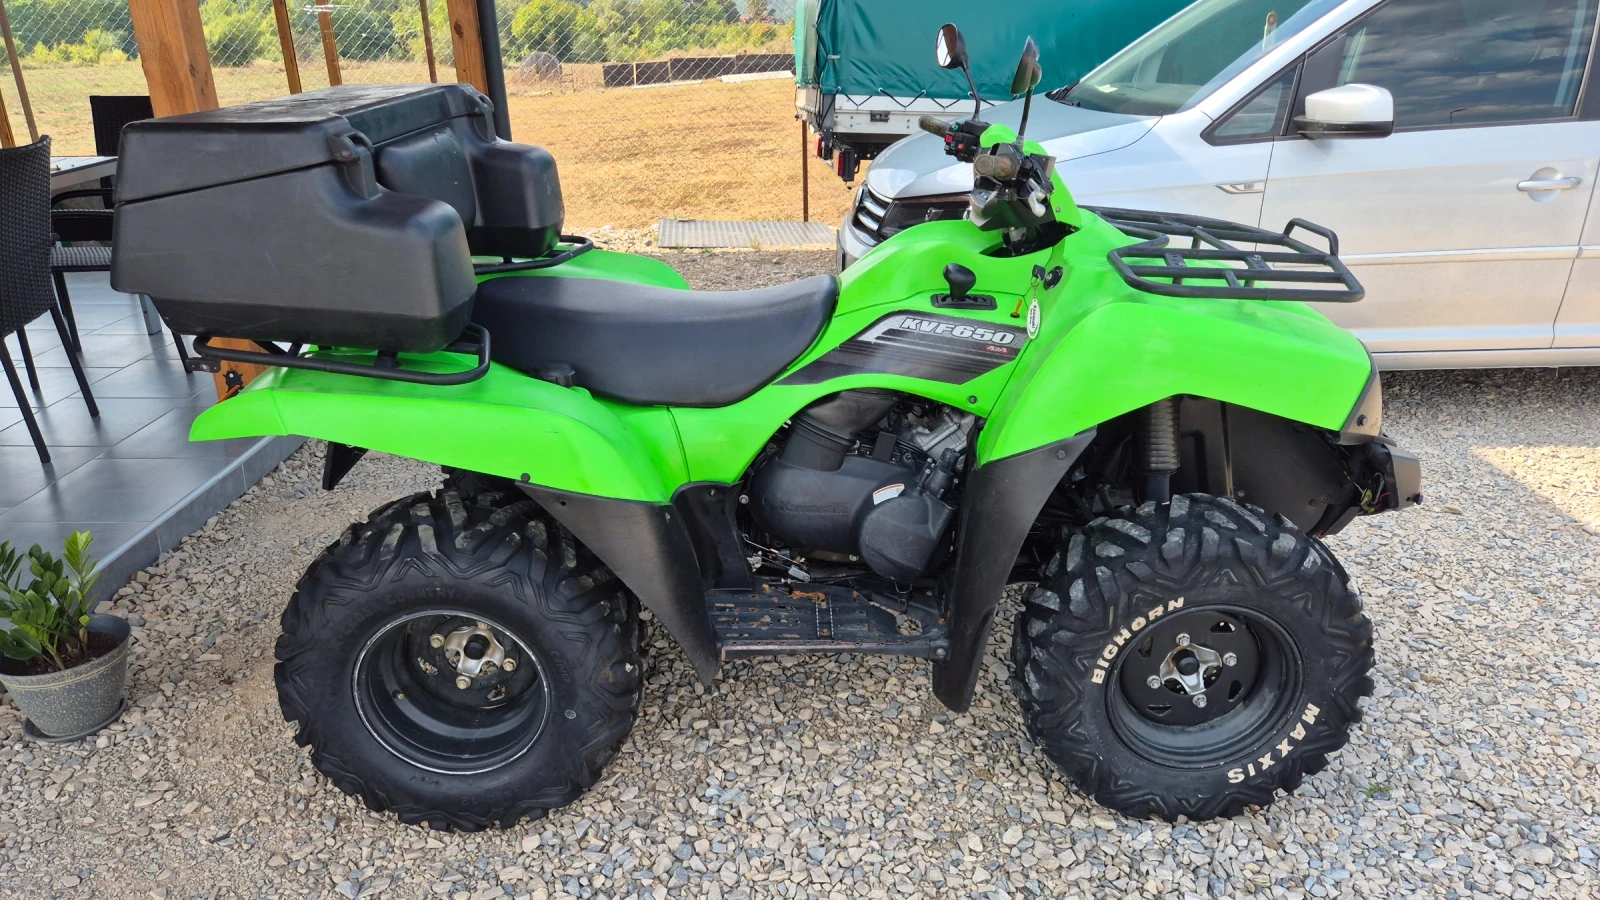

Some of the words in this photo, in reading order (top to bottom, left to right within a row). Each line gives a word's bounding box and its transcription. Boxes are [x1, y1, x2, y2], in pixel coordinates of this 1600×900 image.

[900, 317, 1015, 344] KVF650
[779, 500, 848, 515] Kawasaki
[1091, 596, 1185, 685] BIGHORN
[1227, 703, 1321, 784] MAXXIS
